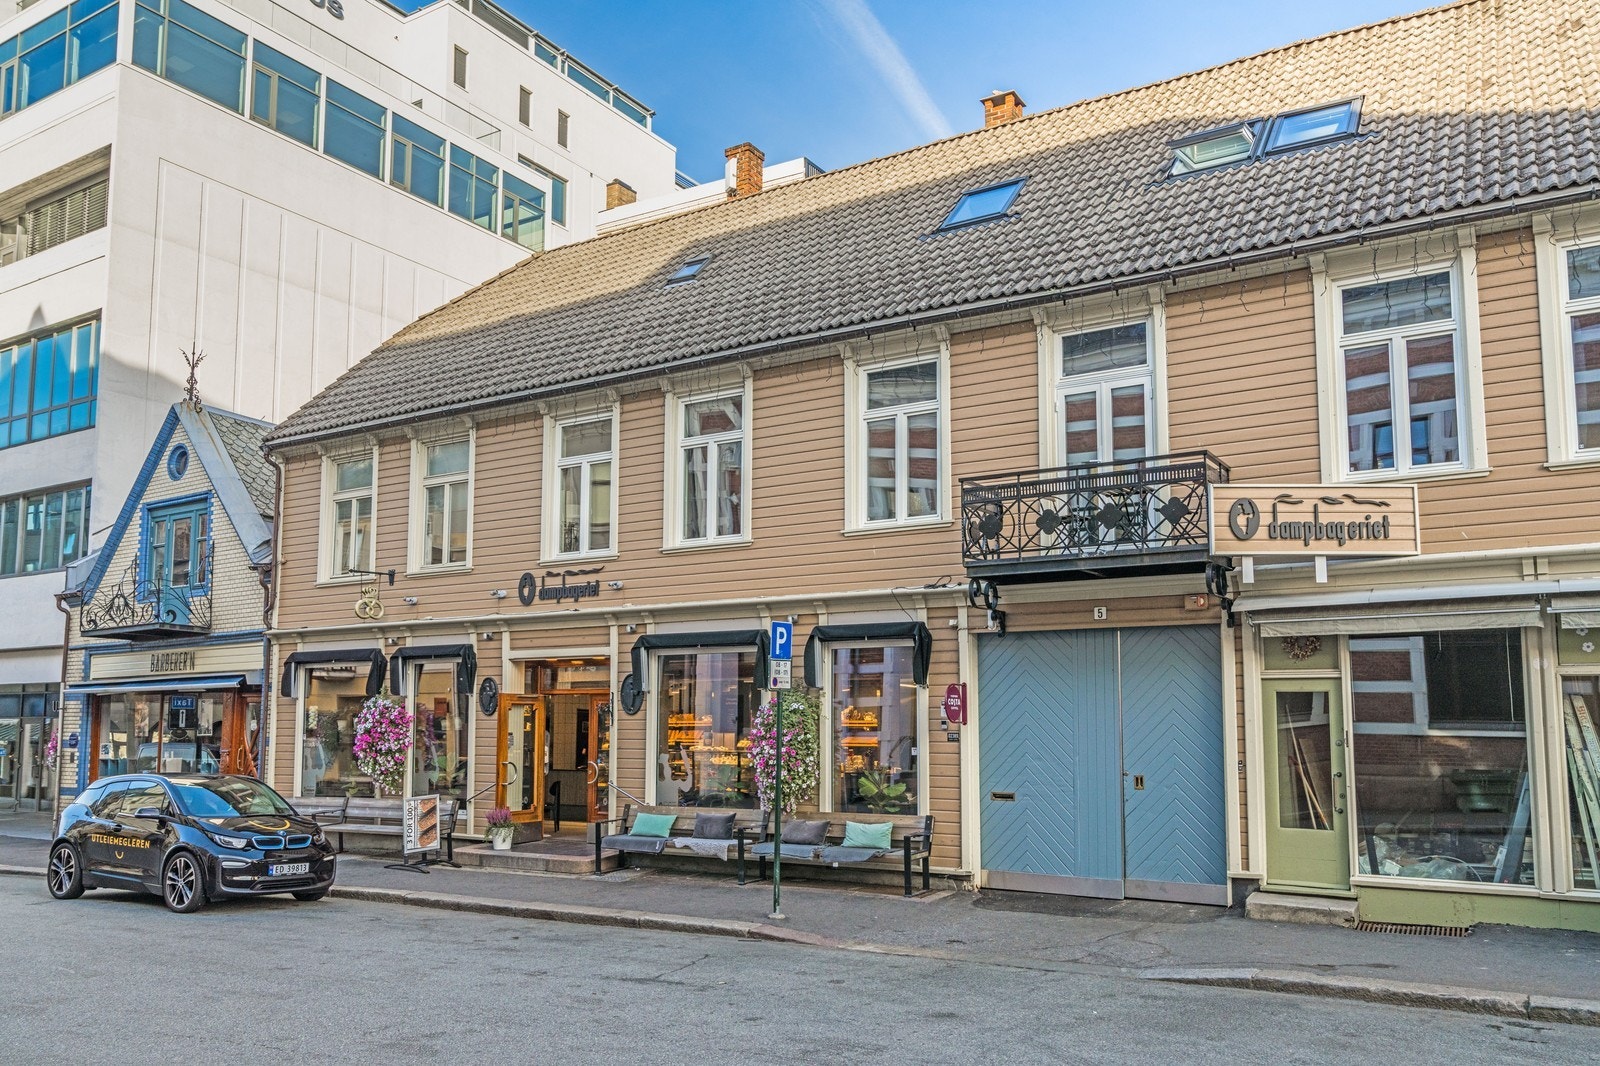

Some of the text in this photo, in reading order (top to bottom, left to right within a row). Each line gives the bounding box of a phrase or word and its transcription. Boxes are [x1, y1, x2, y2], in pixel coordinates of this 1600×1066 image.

[1268, 502, 1391, 547] dampbageriet
[538, 573, 600, 604] dampbageriet
[1097, 608, 1103, 619] 5
[776, 626, 787, 655] P
[948, 698, 960, 706] COSTA
[91, 833, 151, 849] UTLEIEMEGLEREN
[275, 864, 307, 873] ED 39813
